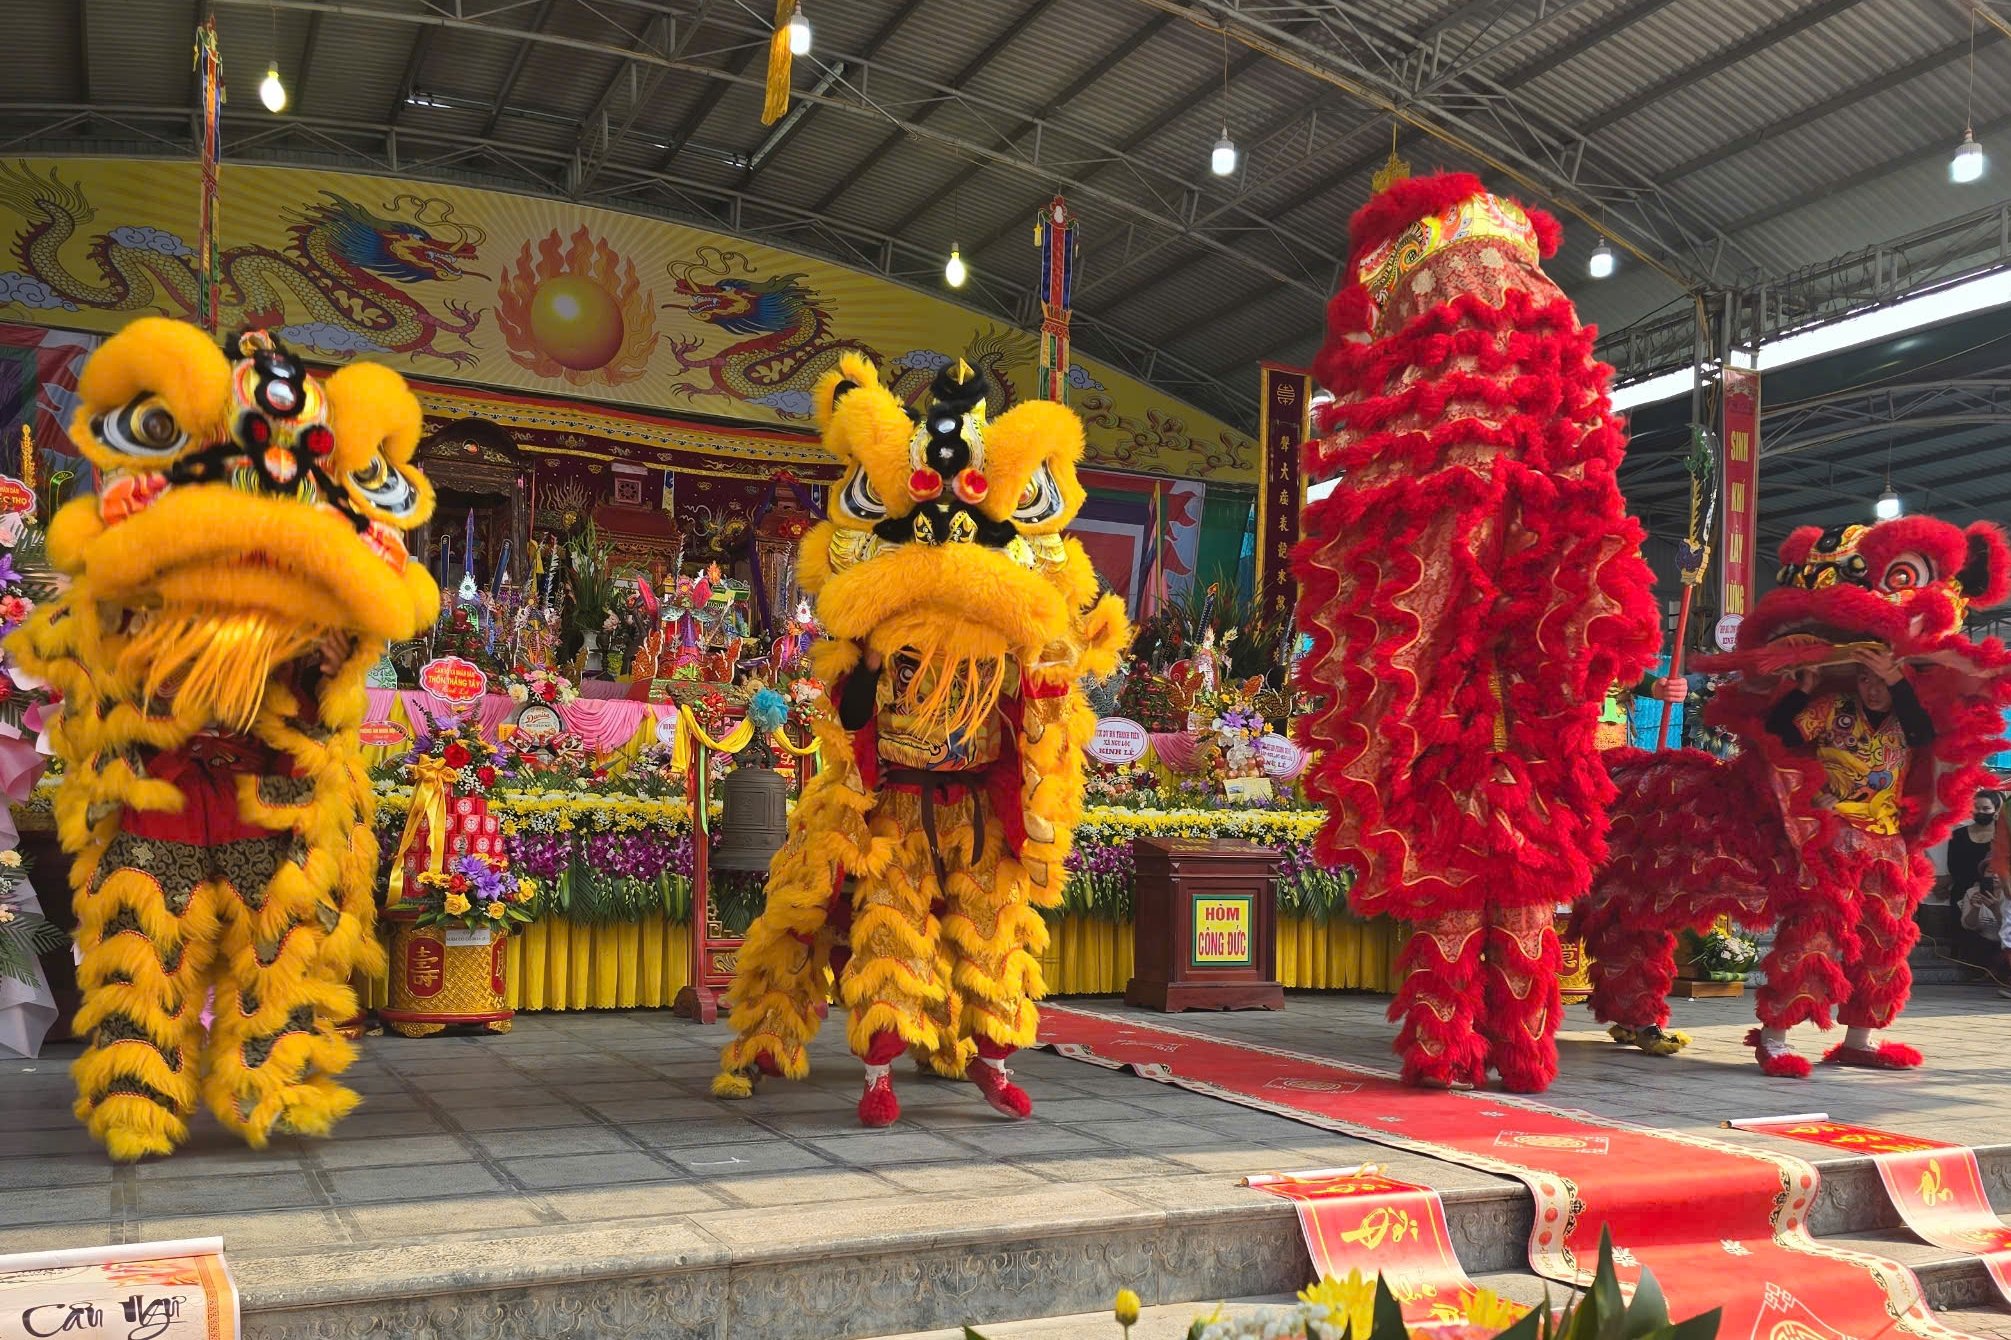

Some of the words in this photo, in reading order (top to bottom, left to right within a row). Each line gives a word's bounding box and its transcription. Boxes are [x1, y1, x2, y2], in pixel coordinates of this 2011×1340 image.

[1730, 430, 1749, 462] SINH
[1730, 478, 1746, 513] KHÍ
[428, 675, 446, 685] THÔN
[447, 676, 467, 687] THẮNG
[469, 679, 480, 688] TÂY
[1099, 746, 1122, 755] KÍNH
[1205, 903, 1240, 921] HÒM
[1198, 926, 1225, 956] CÔNG
[1227, 924, 1247, 956] ĐỨC
